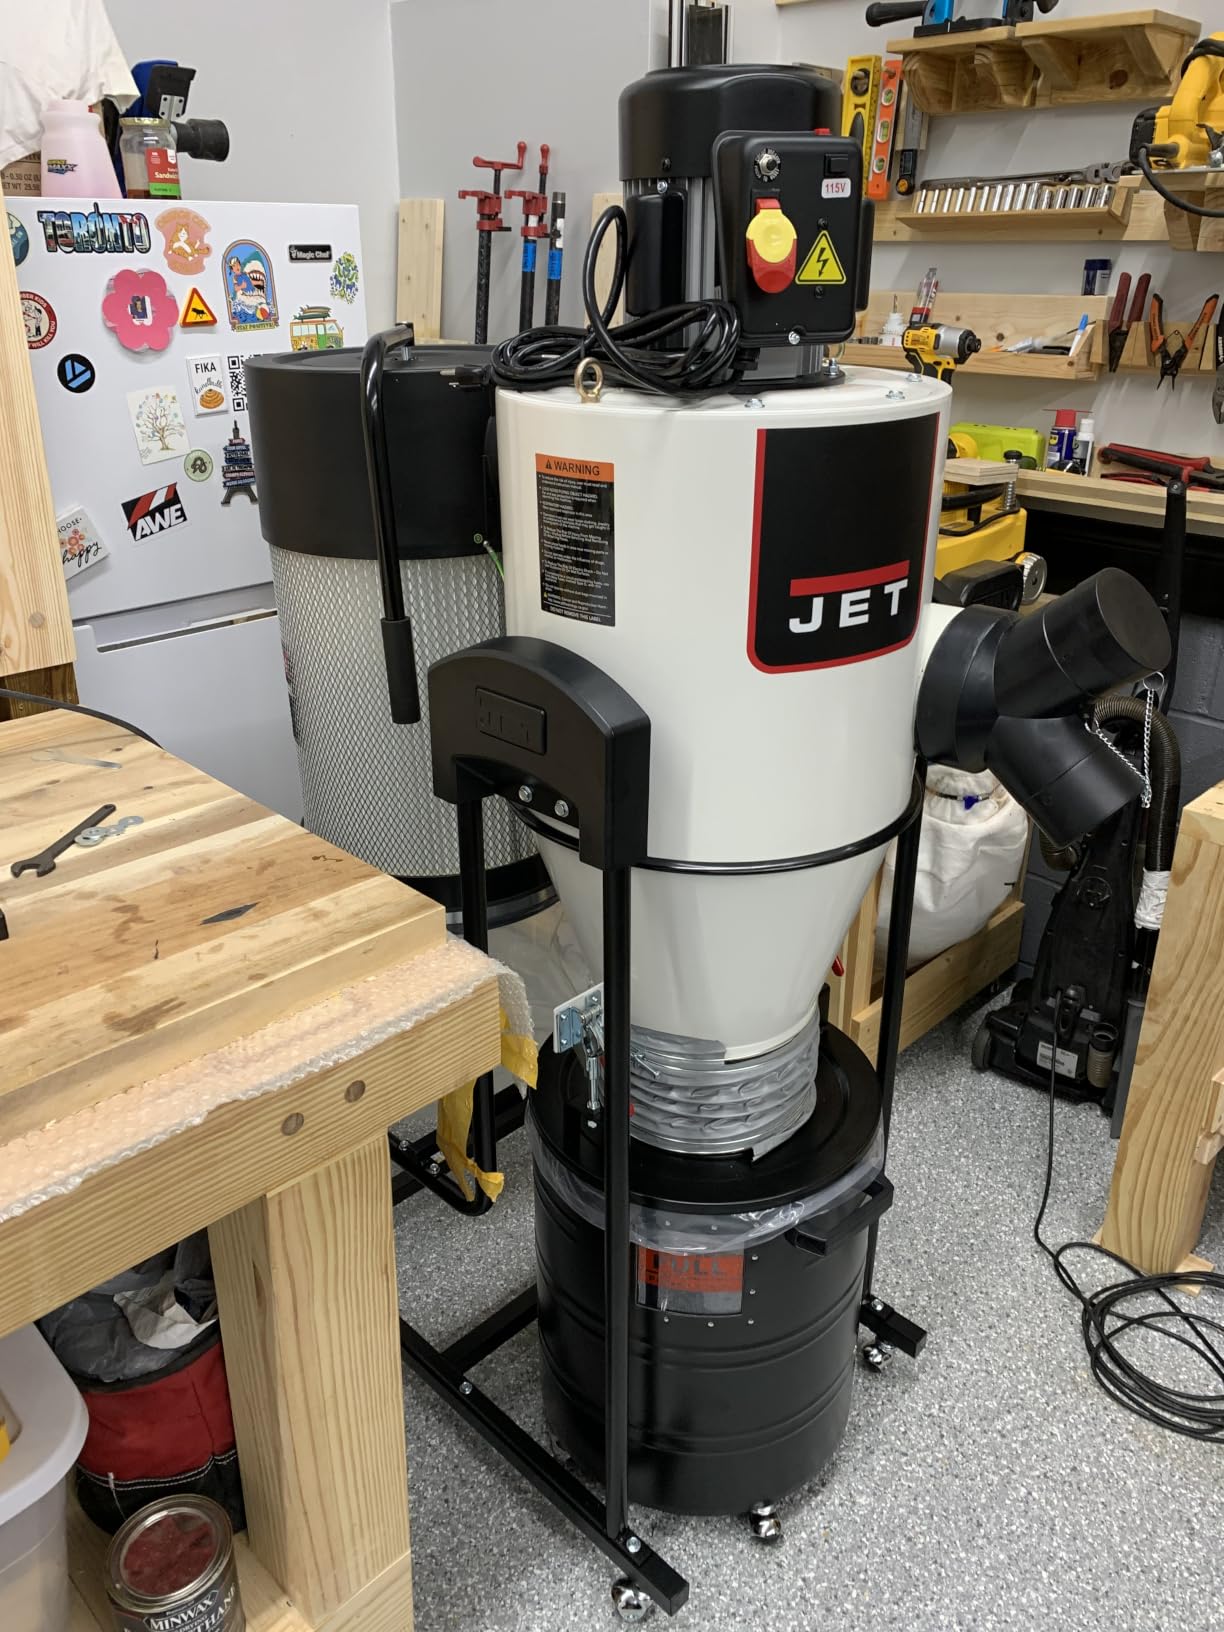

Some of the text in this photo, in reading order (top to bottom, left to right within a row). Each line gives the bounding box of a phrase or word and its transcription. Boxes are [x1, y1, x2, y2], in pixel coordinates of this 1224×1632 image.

[825, 183, 846, 193] 115V
[37, 206, 152, 254] TORONTO
[297, 251, 314, 260] Magic
[195, 362, 216, 374] FIKA
[554, 460, 600, 476] WARNING
[58, 518, 80, 532] HOOSE
[136, 504, 184, 540] AWE
[62, 541, 102, 568] happy
[789, 579, 908, 633] JET
[150, 1598, 212, 1631] MINWAX
